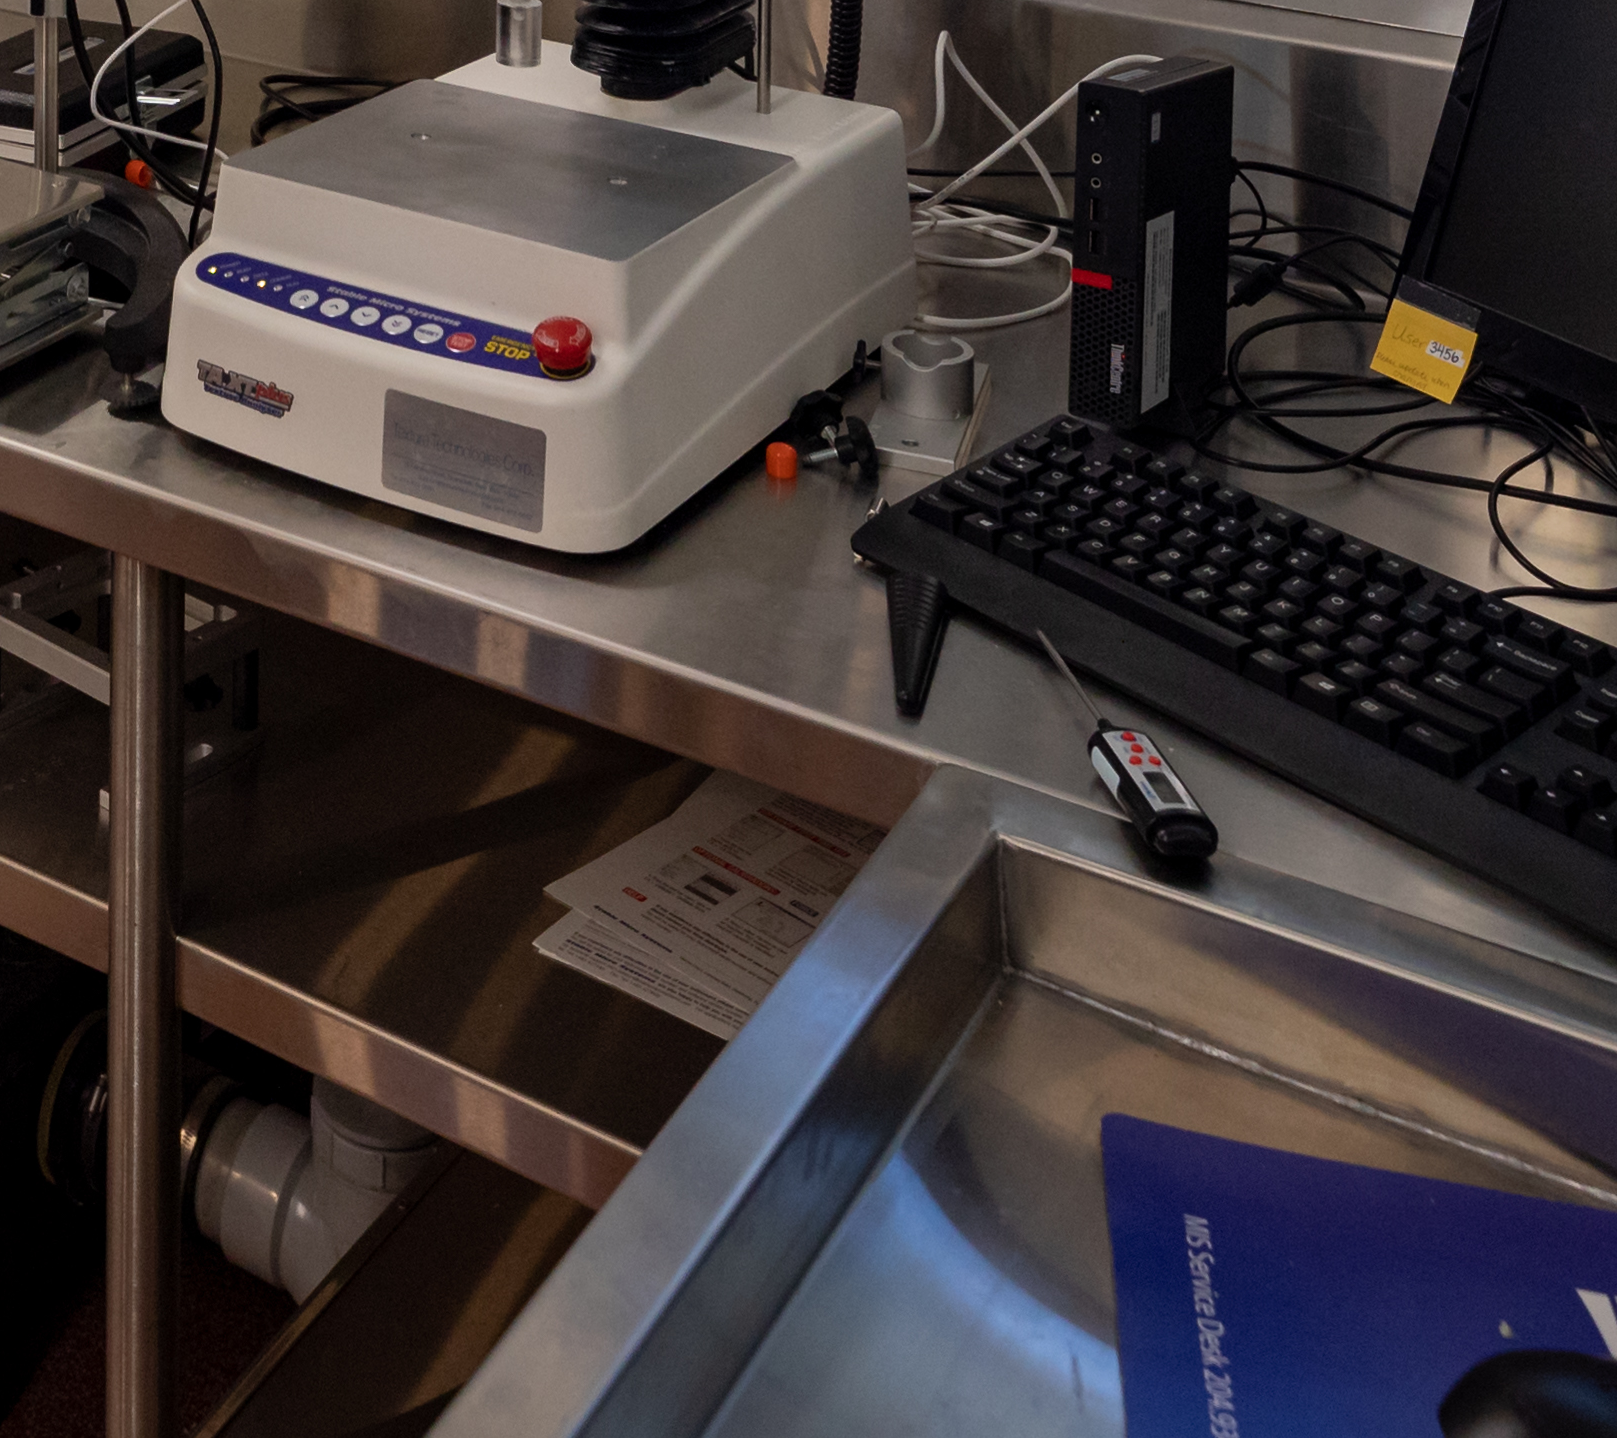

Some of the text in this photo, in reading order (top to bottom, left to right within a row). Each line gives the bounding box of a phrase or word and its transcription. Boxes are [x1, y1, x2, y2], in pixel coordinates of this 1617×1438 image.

[327, 286, 461, 327] Stable Micro Systems
[484, 341, 530, 360] STOP
[1392, 324, 1460, 364] User 3456
[1110, 343, 1124, 394] ThinkCentre
[504, 455, 536, 477] Corp.
[1184, 1213, 1212, 1250] MIS
[1188, 1248, 1220, 1315] Service
[1196, 1317, 1231, 1366] Desk
